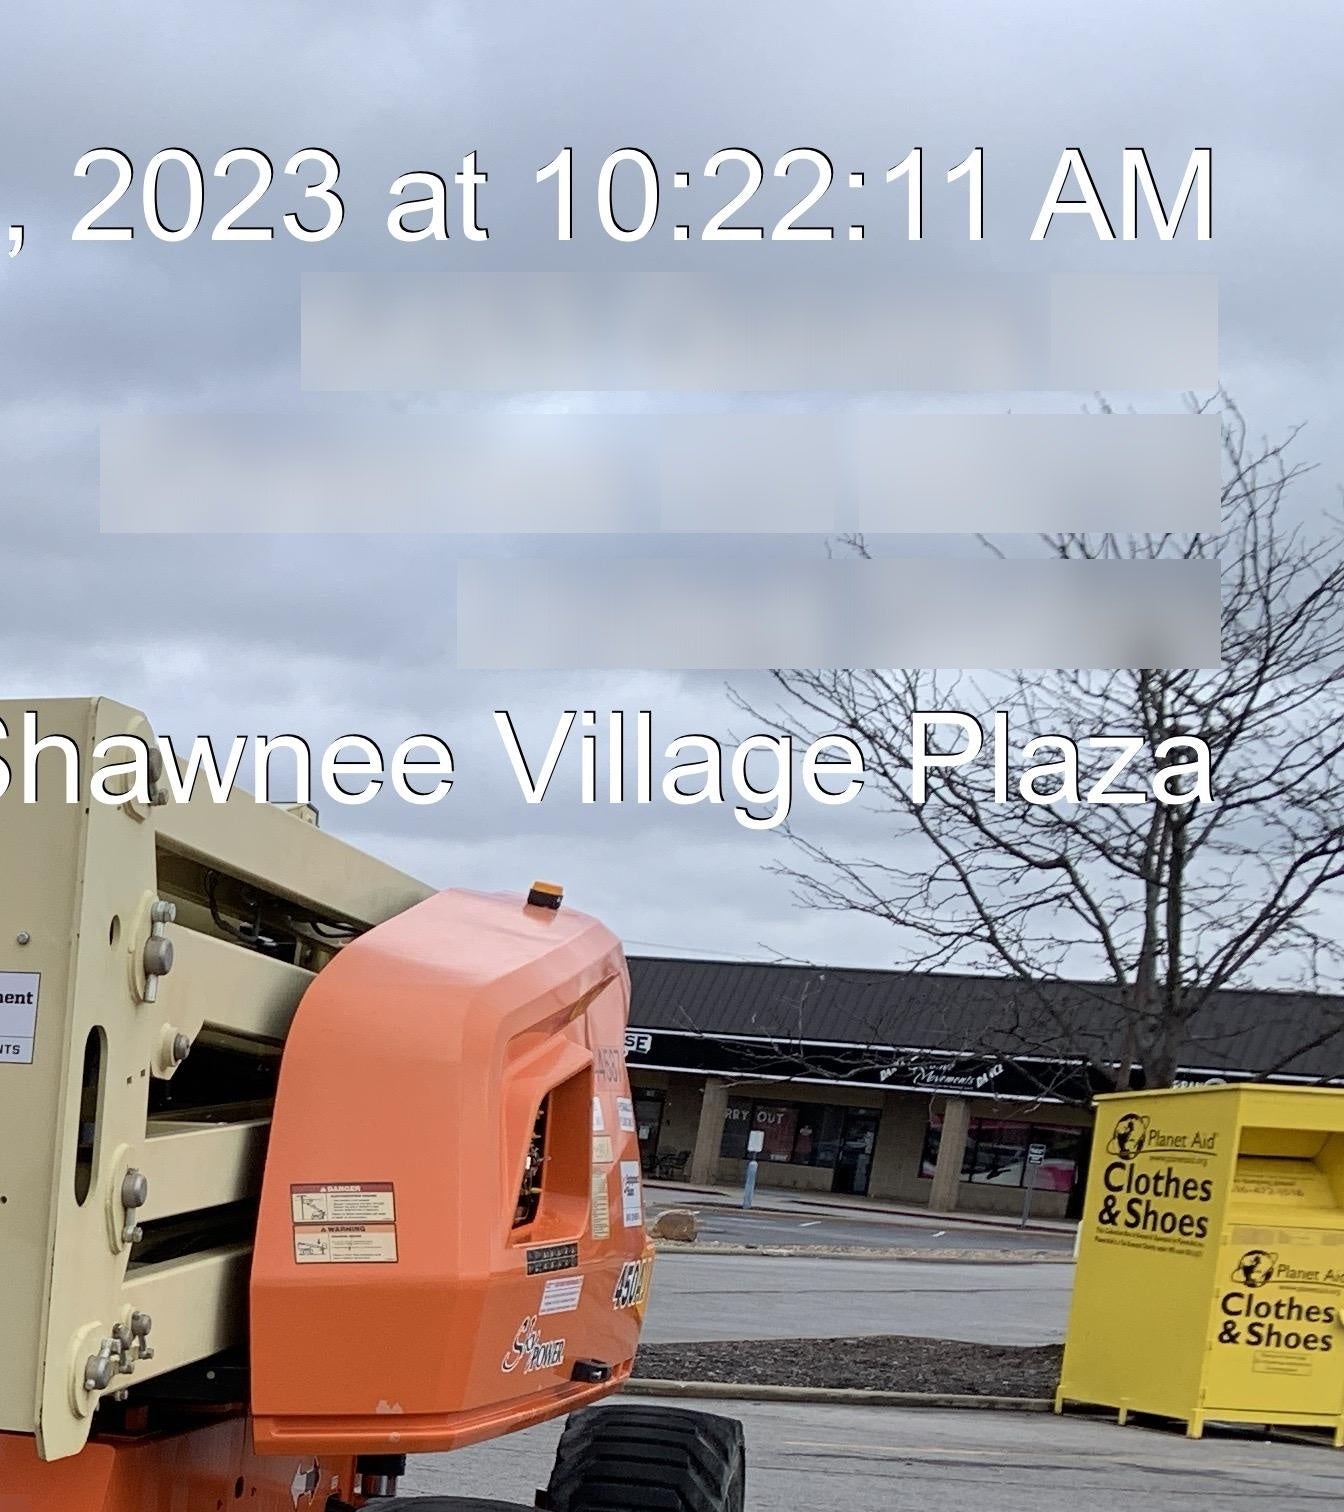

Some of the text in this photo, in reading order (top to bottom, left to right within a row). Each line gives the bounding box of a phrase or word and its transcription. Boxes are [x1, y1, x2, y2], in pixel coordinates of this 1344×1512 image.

[757, 1111, 784, 1124] OUT
[1148, 1129, 1216, 1149] Planet Aid
[326, 1185, 362, 1193] DANGER
[1104, 1161, 1214, 1202] Clothes
[1098, 1194, 1209, 1239] & Shoes
[328, 1225, 366, 1233] WARNING
[1277, 1264, 1320, 1281] Planet
[1221, 1292, 1335, 1324] Clothes
[1218, 1319, 1333, 1351] & Shoes
